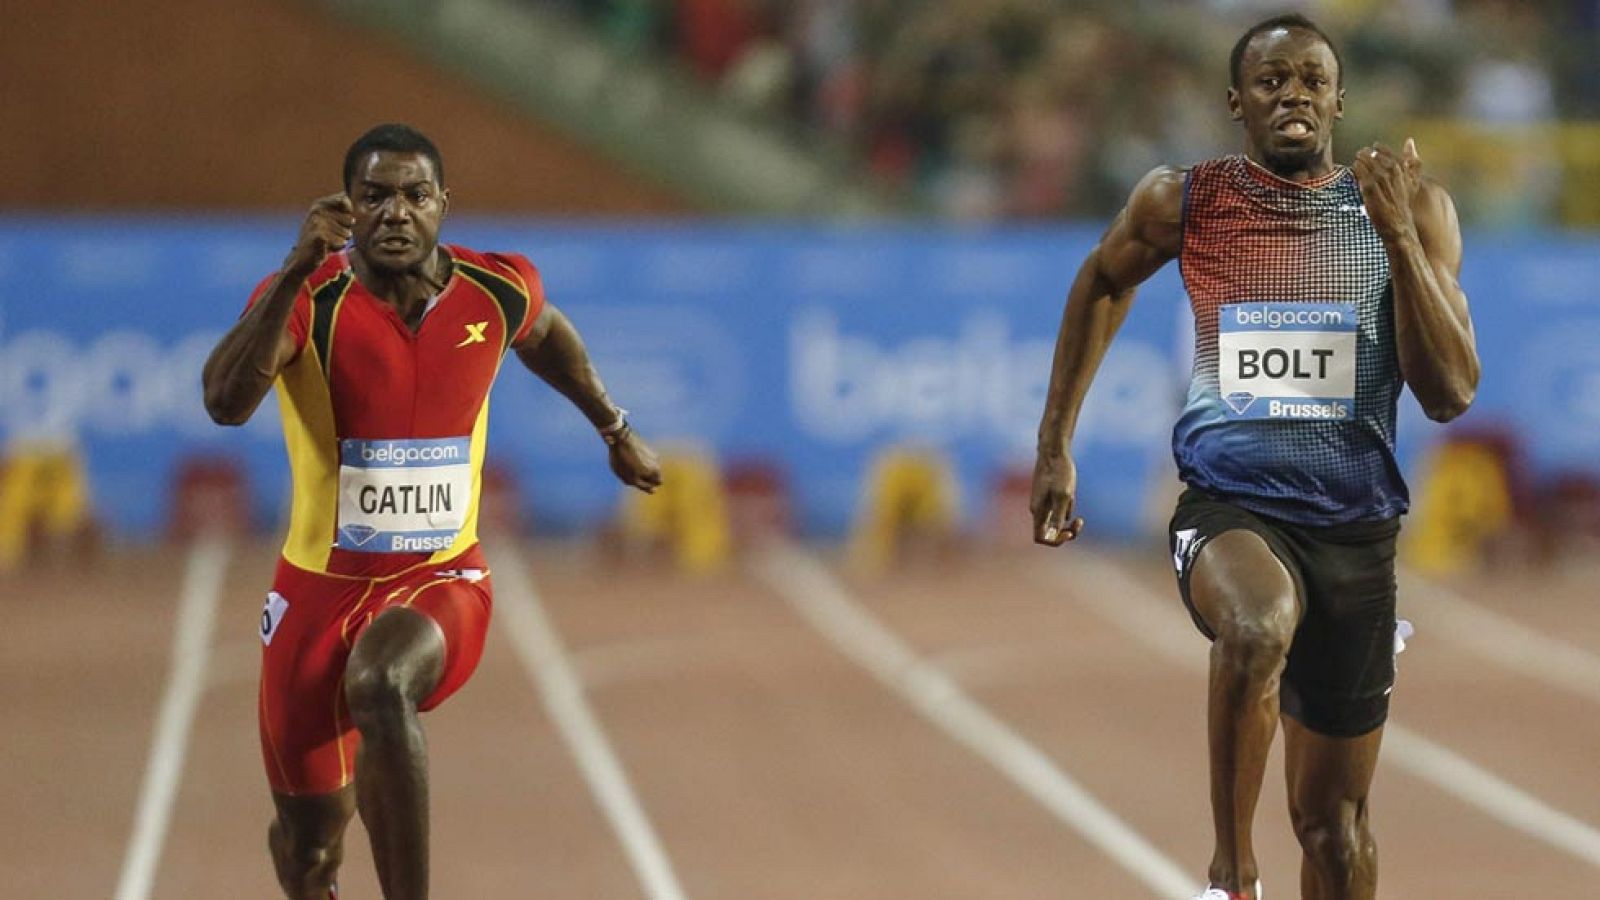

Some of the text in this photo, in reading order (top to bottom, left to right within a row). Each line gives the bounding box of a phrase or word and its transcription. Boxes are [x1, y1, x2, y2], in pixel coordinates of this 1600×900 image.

[1236, 306, 1342, 328] belgacom
[1238, 348, 1334, 380] BOLT
[1269, 400, 1347, 418] Brussels
[361, 443, 458, 464] belgacom
[359, 483, 452, 514] GATLIN
